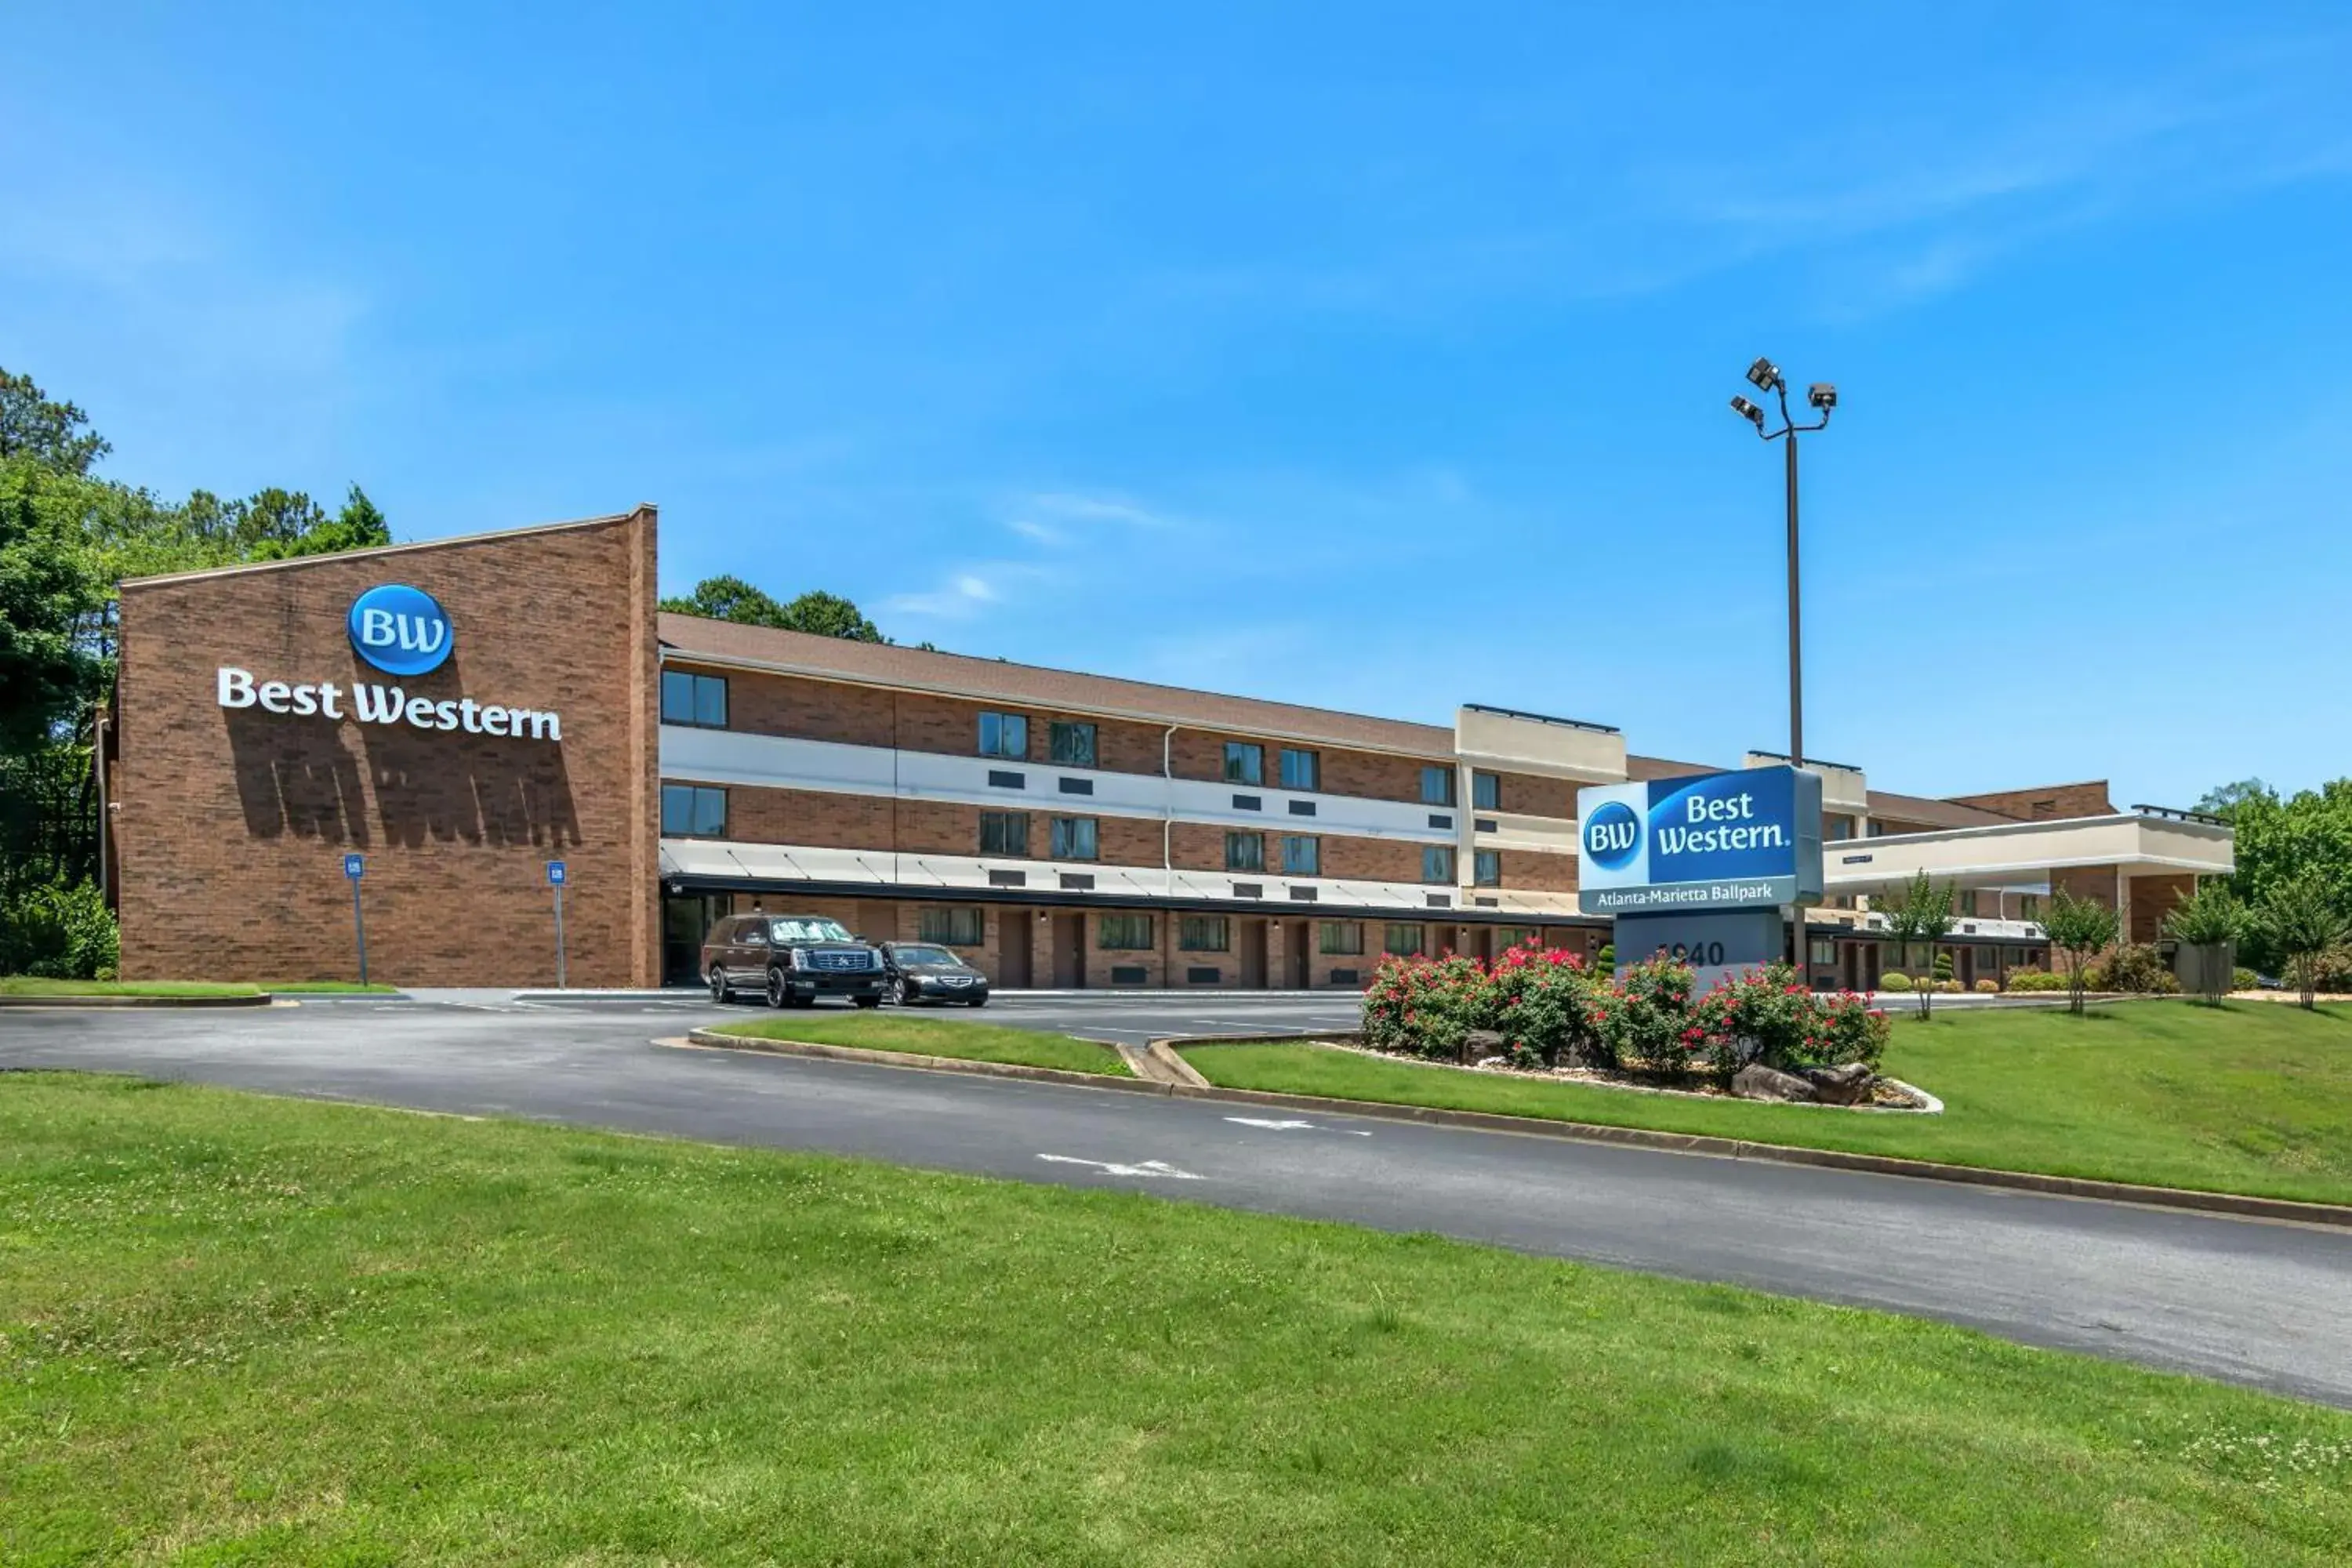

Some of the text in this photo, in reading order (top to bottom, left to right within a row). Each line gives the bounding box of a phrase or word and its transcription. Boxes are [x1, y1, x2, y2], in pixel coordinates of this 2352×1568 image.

[362, 608, 445, 653] BW
[217, 666, 562, 741] Best Western
[1686, 793, 1754, 823] Best
[1590, 822, 1635, 852] BW
[1597, 884, 1773, 907] Atlanta-Marietta Ballpark
